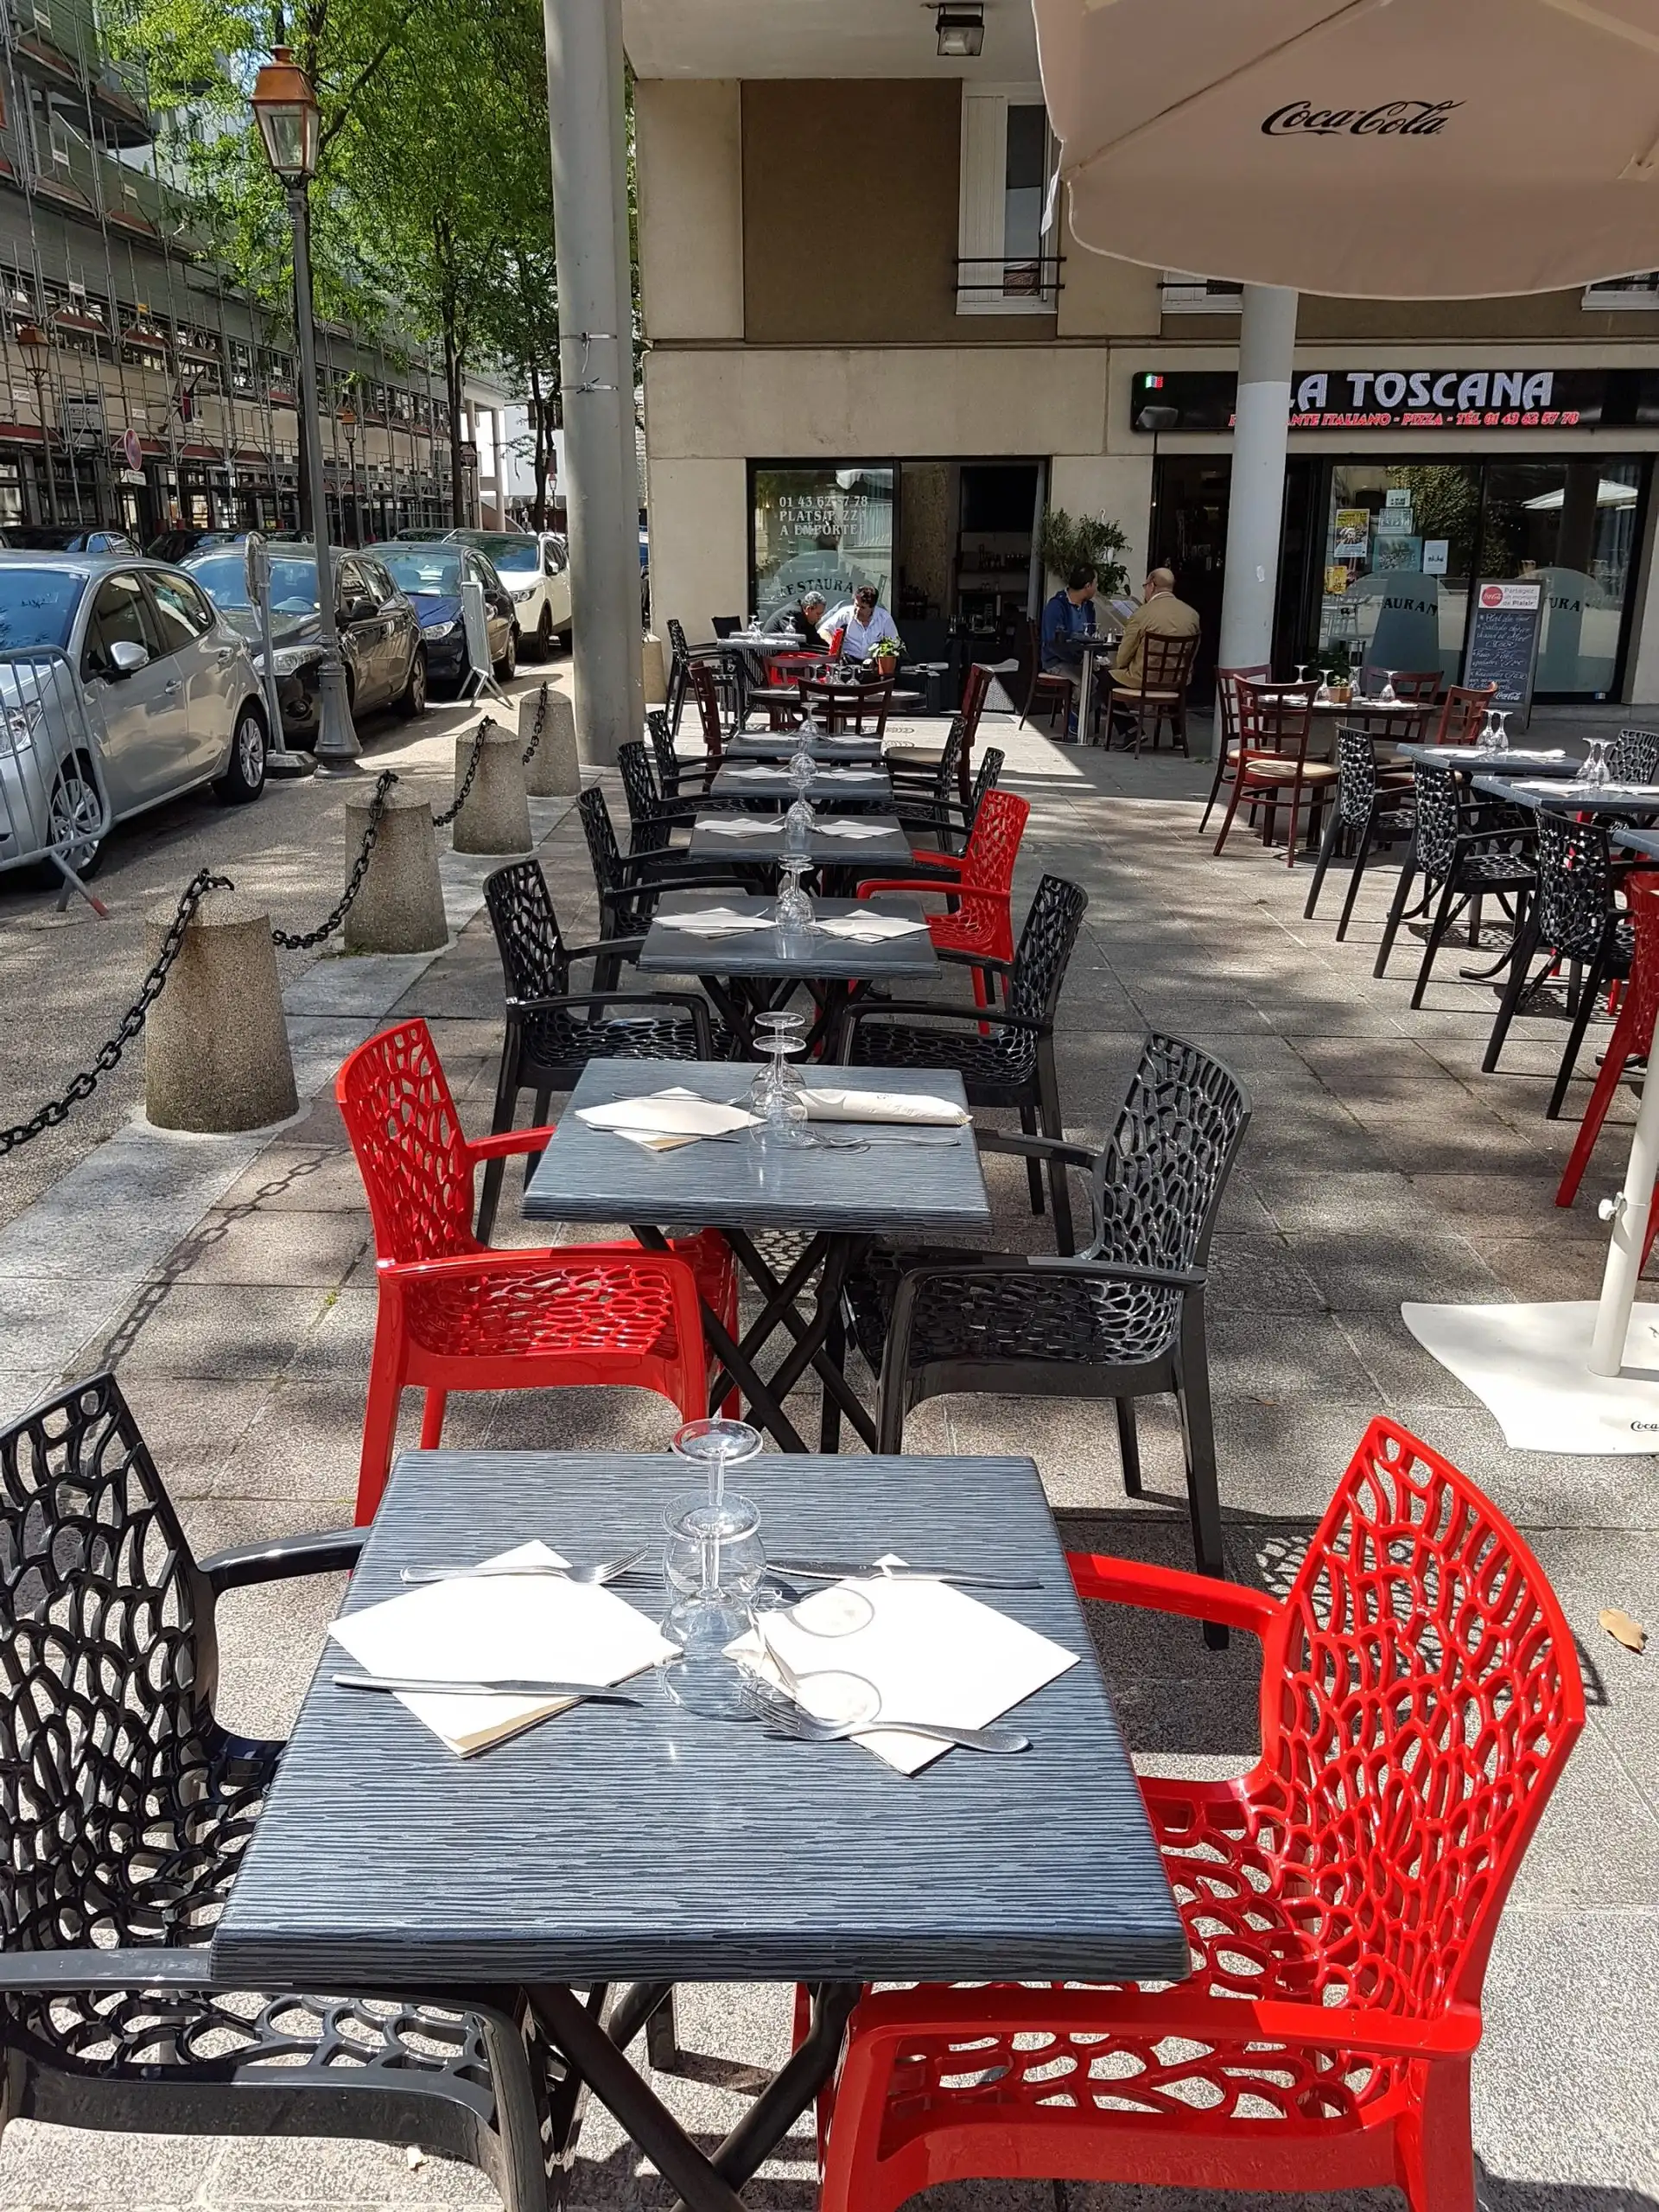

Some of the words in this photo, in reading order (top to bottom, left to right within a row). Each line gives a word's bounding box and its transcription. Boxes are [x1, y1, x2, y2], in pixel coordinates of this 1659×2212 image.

[1261, 100, 1466, 136] Coca-Cola
[1289, 373, 1328, 412] A
[1346, 372, 1554, 411] TOSCANA
[1321, 413, 1391, 426] ITALIANO
[1401, 412, 1443, 426] PIZZA
[1456, 410, 1481, 425] TÉL
[1484, 412, 1498, 425] 01
[1502, 411, 1519, 425] 43
[1522, 411, 1539, 424] 62
[1541, 411, 1560, 424] 57
[1560, 411, 1580, 424] 78
[779, 496, 793, 507] 01
[798, 495, 812, 507] 43
[817, 496, 830, 508] 62
[854, 495, 868, 506] 78
[780, 524, 788, 536] A
[780, 578, 854, 596] ESTAURA
